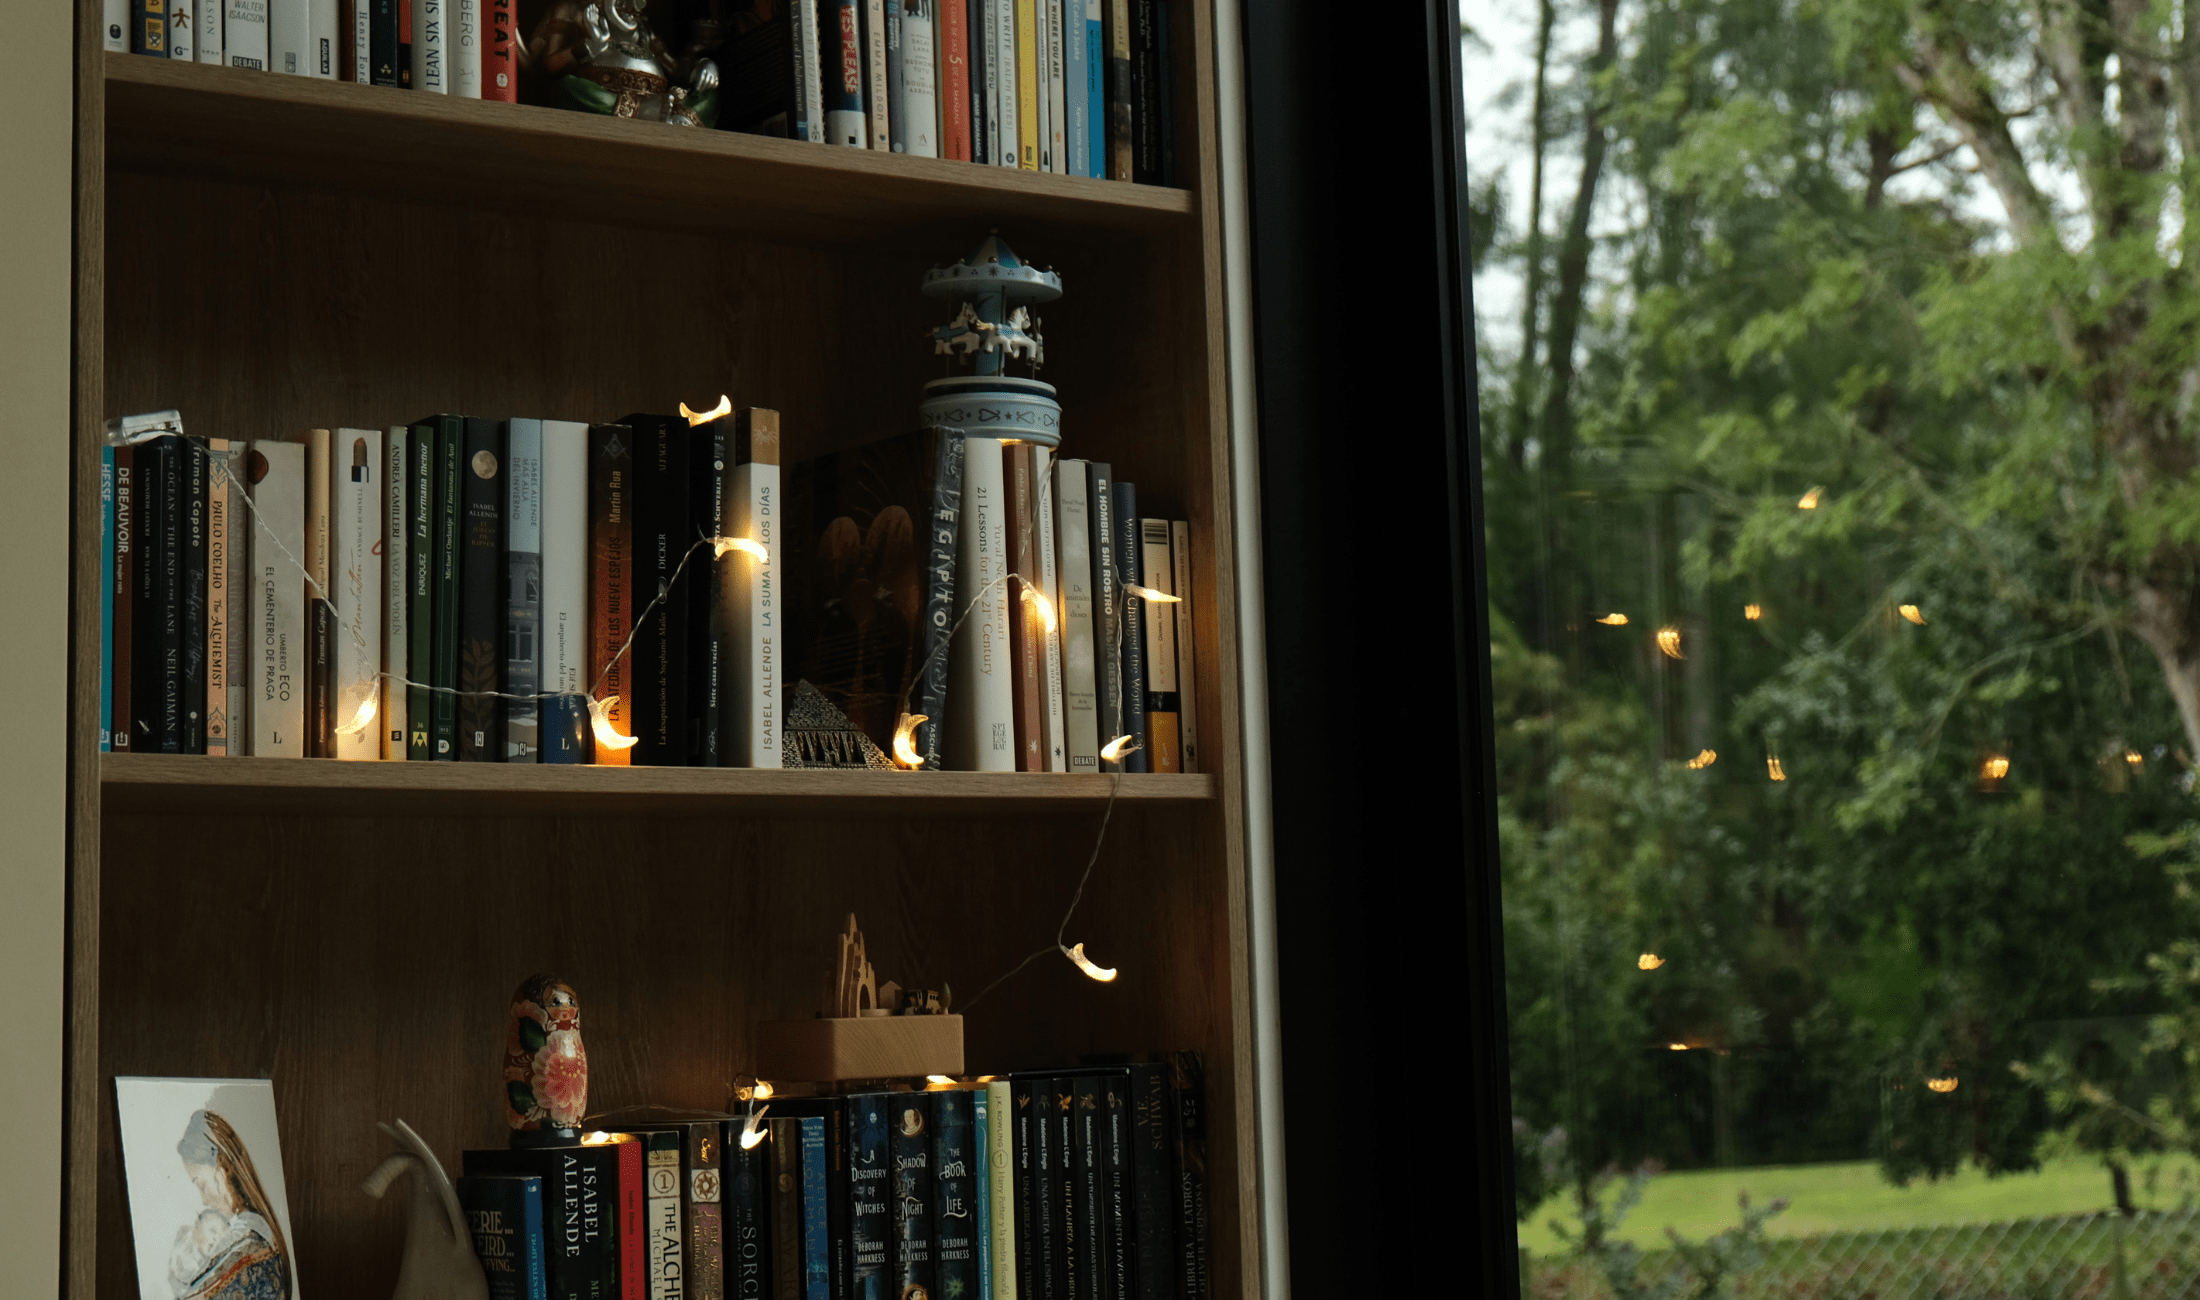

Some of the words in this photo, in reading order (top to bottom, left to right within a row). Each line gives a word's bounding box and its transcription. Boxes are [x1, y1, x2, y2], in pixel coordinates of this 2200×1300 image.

[228, 10, 266, 24] ISAACSON
[234, 0, 264, 12] WALTER
[841, 8, 854, 33] YES
[359, 11, 368, 48] Henry
[426, 19, 440, 47] SIX
[1003, 16, 1012, 51] WRITE
[1051, 6, 1059, 38] WHERE
[232, 56, 263, 71] DEBATE
[320, 38, 330, 75] AGUILAR
[873, 32, 883, 67] EMMA
[949, 55, 962, 65] 5
[1052, 41, 1060, 59] YOU
[426, 50, 440, 86] LEAN
[844, 41, 859, 94] PLEASE
[1053, 62, 1061, 80] ARE
[875, 73, 886, 121] MILDON
[391, 445, 400, 482] ANDREA
[418, 442, 428, 477] menor
[658, 423, 668, 474] ALFAGUARA
[118, 467, 129, 485] DE
[512, 457, 521, 472] DEL
[530, 458, 539, 487] ISABEL
[609, 468, 621, 487] Rua
[167, 473, 176, 511] OCEAN
[512, 475, 521, 521] INVIERNO
[713, 476, 722, 522] SCHWEBLIN
[978, 487, 987, 500] 21
[1098, 478, 1107, 492] EL
[391, 486, 401, 538] CAMILLERI
[417, 478, 428, 523] hermana
[530, 489, 539, 528] ALLENDE
[609, 489, 621, 521] Martin
[758, 486, 770, 516] DÍAS
[118, 487, 129, 553] BEAUVOIR
[190, 500, 202, 547] Capote
[213, 501, 224, 537] PAULO
[417, 525, 427, 538] La
[760, 520, 771, 545] LOS
[977, 504, 989, 553] Lessons
[1098, 495, 1110, 544] HOMBRE
[167, 526, 175, 549] THE
[392, 543, 400, 556] LA
[658, 533, 667, 570] DICKER
[994, 525, 1003, 558] Yuval
[1124, 518, 1136, 564] Women
[167, 552, 175, 576] END
[212, 542, 223, 589] COELHO
[392, 557, 401, 578] VOZ
[445, 551, 453, 580] Michael
[609, 534, 621, 577] ESPEJOS
[979, 555, 991, 574] for
[1101, 547, 1111, 566] SIN
[266, 567, 274, 577] EL
[418, 552, 427, 596] ENRIQUEZ
[392, 581, 401, 598] DEL
[609, 581, 621, 613] NUEVE
[761, 570, 772, 607] SUMA
[1072, 584, 1083, 594] De
[1102, 569, 1113, 615] ROSTRO
[167, 605, 175, 635] LANE
[213, 600, 222, 614] The
[266, 580, 275, 646] CEMENTERIO
[317, 606, 328, 634] Capote
[391, 601, 401, 636] VIOLÍN
[559, 612, 567, 621] El
[761, 611, 772, 627] LA
[996, 600, 1007, 640] Harari
[609, 617, 621, 636] LOS
[658, 611, 668, 637] Mailer
[1105, 618, 1115, 659] MASHA
[1125, 597, 1141, 650] Changed
[209, 616, 222, 690] ALCHEMIST
[266, 649, 274, 662] DE
[317, 636, 326, 666] Truman
[557, 622, 567, 661] arquitecto
[609, 638, 621, 652] DE
[657, 638, 669, 675] Stephanie
[980, 623, 994, 676] Century
[166, 648, 176, 677] NEIL
[559, 662, 567, 674] del
[568, 667, 577, 683] Elif
[762, 636, 773, 698] ALLENDE
[1129, 654, 1139, 674] the
[266, 665, 275, 702] PRAGA
[280, 674, 290, 702] ECO
[658, 676, 667, 686] de
[1106, 661, 1118, 707] GESSEN
[166, 680, 176, 732] GAIMAN
[657, 687, 669, 735] desaparición
[1129, 678, 1142, 715] World
[274, 731, 283, 744] L
[658, 736, 667, 746] La
[762, 702, 773, 750] ISABEL
[928, 723, 938, 762] TASCHEN
[1073, 755, 1096, 768] DEBATE
[1136, 1095, 1149, 1127] V.E.
[1149, 1075, 1163, 1151] SCHWAB
[996, 1110, 1004, 1148] ROWLING
[1020, 1116, 1028, 1147] Madeleine
[1040, 1117, 1048, 1148] Madeleine
[1062, 1116, 1070, 1147] Madeleine
[1085, 1115, 1093, 1146] Madeleine
[1111, 1114, 1120, 1143] Madeleine
[896, 1152, 927, 1171] SHADOW
[948, 1147, 961, 1158] THE
[1086, 1145, 1094, 1168] L'Engle
[1112, 1143, 1121, 1166] L'Engle
[659, 1174, 669, 1190] 1
[851, 1166, 887, 1183] DISCOVERY
[906, 1177, 916, 1191] OF
[938, 1160, 967, 1181] BOOK
[1087, 1172, 1095, 1183] UN
[1113, 1171, 1121, 1188] UN
[805, 1151, 816, 1250] HOFFMAN
[867, 1186, 876, 1197] OF
[949, 1182, 958, 1193] OF
[1022, 1175, 1030, 1198] UNA
[1041, 1177, 1049, 1199] UNA
[1064, 1180, 1072, 1196] UN
[1181, 1171, 1194, 1225] LADRÓN
[564, 1154, 580, 1258] ALLENDE
[582, 1165, 599, 1243] ISABEL
[665, 1203, 677, 1233] THE
[854, 1201, 886, 1217] WITCHES
[901, 1195, 924, 1221] NIGHT
[942, 1195, 968, 1218] LIFE
[1042, 1200, 1051, 1234] GRIETA
[1113, 1190, 1124, 1246] MOMENTO
[1194, 1182, 1206, 1243] ESPINOSA
[1023, 1199, 1032, 1240] ARRUGA
[1065, 1198, 1075, 1245] PLANETA
[1089, 1225, 1096, 1236] DE
[693, 1225, 701, 1276] NICHOLAS
[856, 1252, 886, 1264] HARKNESS
[857, 1240, 884, 1253] DEBORAH
[899, 1251, 928, 1263] HARKNESS
[900, 1239, 927, 1250] DEBORAH
[941, 1237, 968, 1249] DEBORAH
[941, 1249, 970, 1261] HARKNESS
[652, 1228, 662, 1292] MICHAEL
[1185, 1241, 1197, 1294] LIBRERA
[1196, 1245, 1207, 1293] OLIVER
